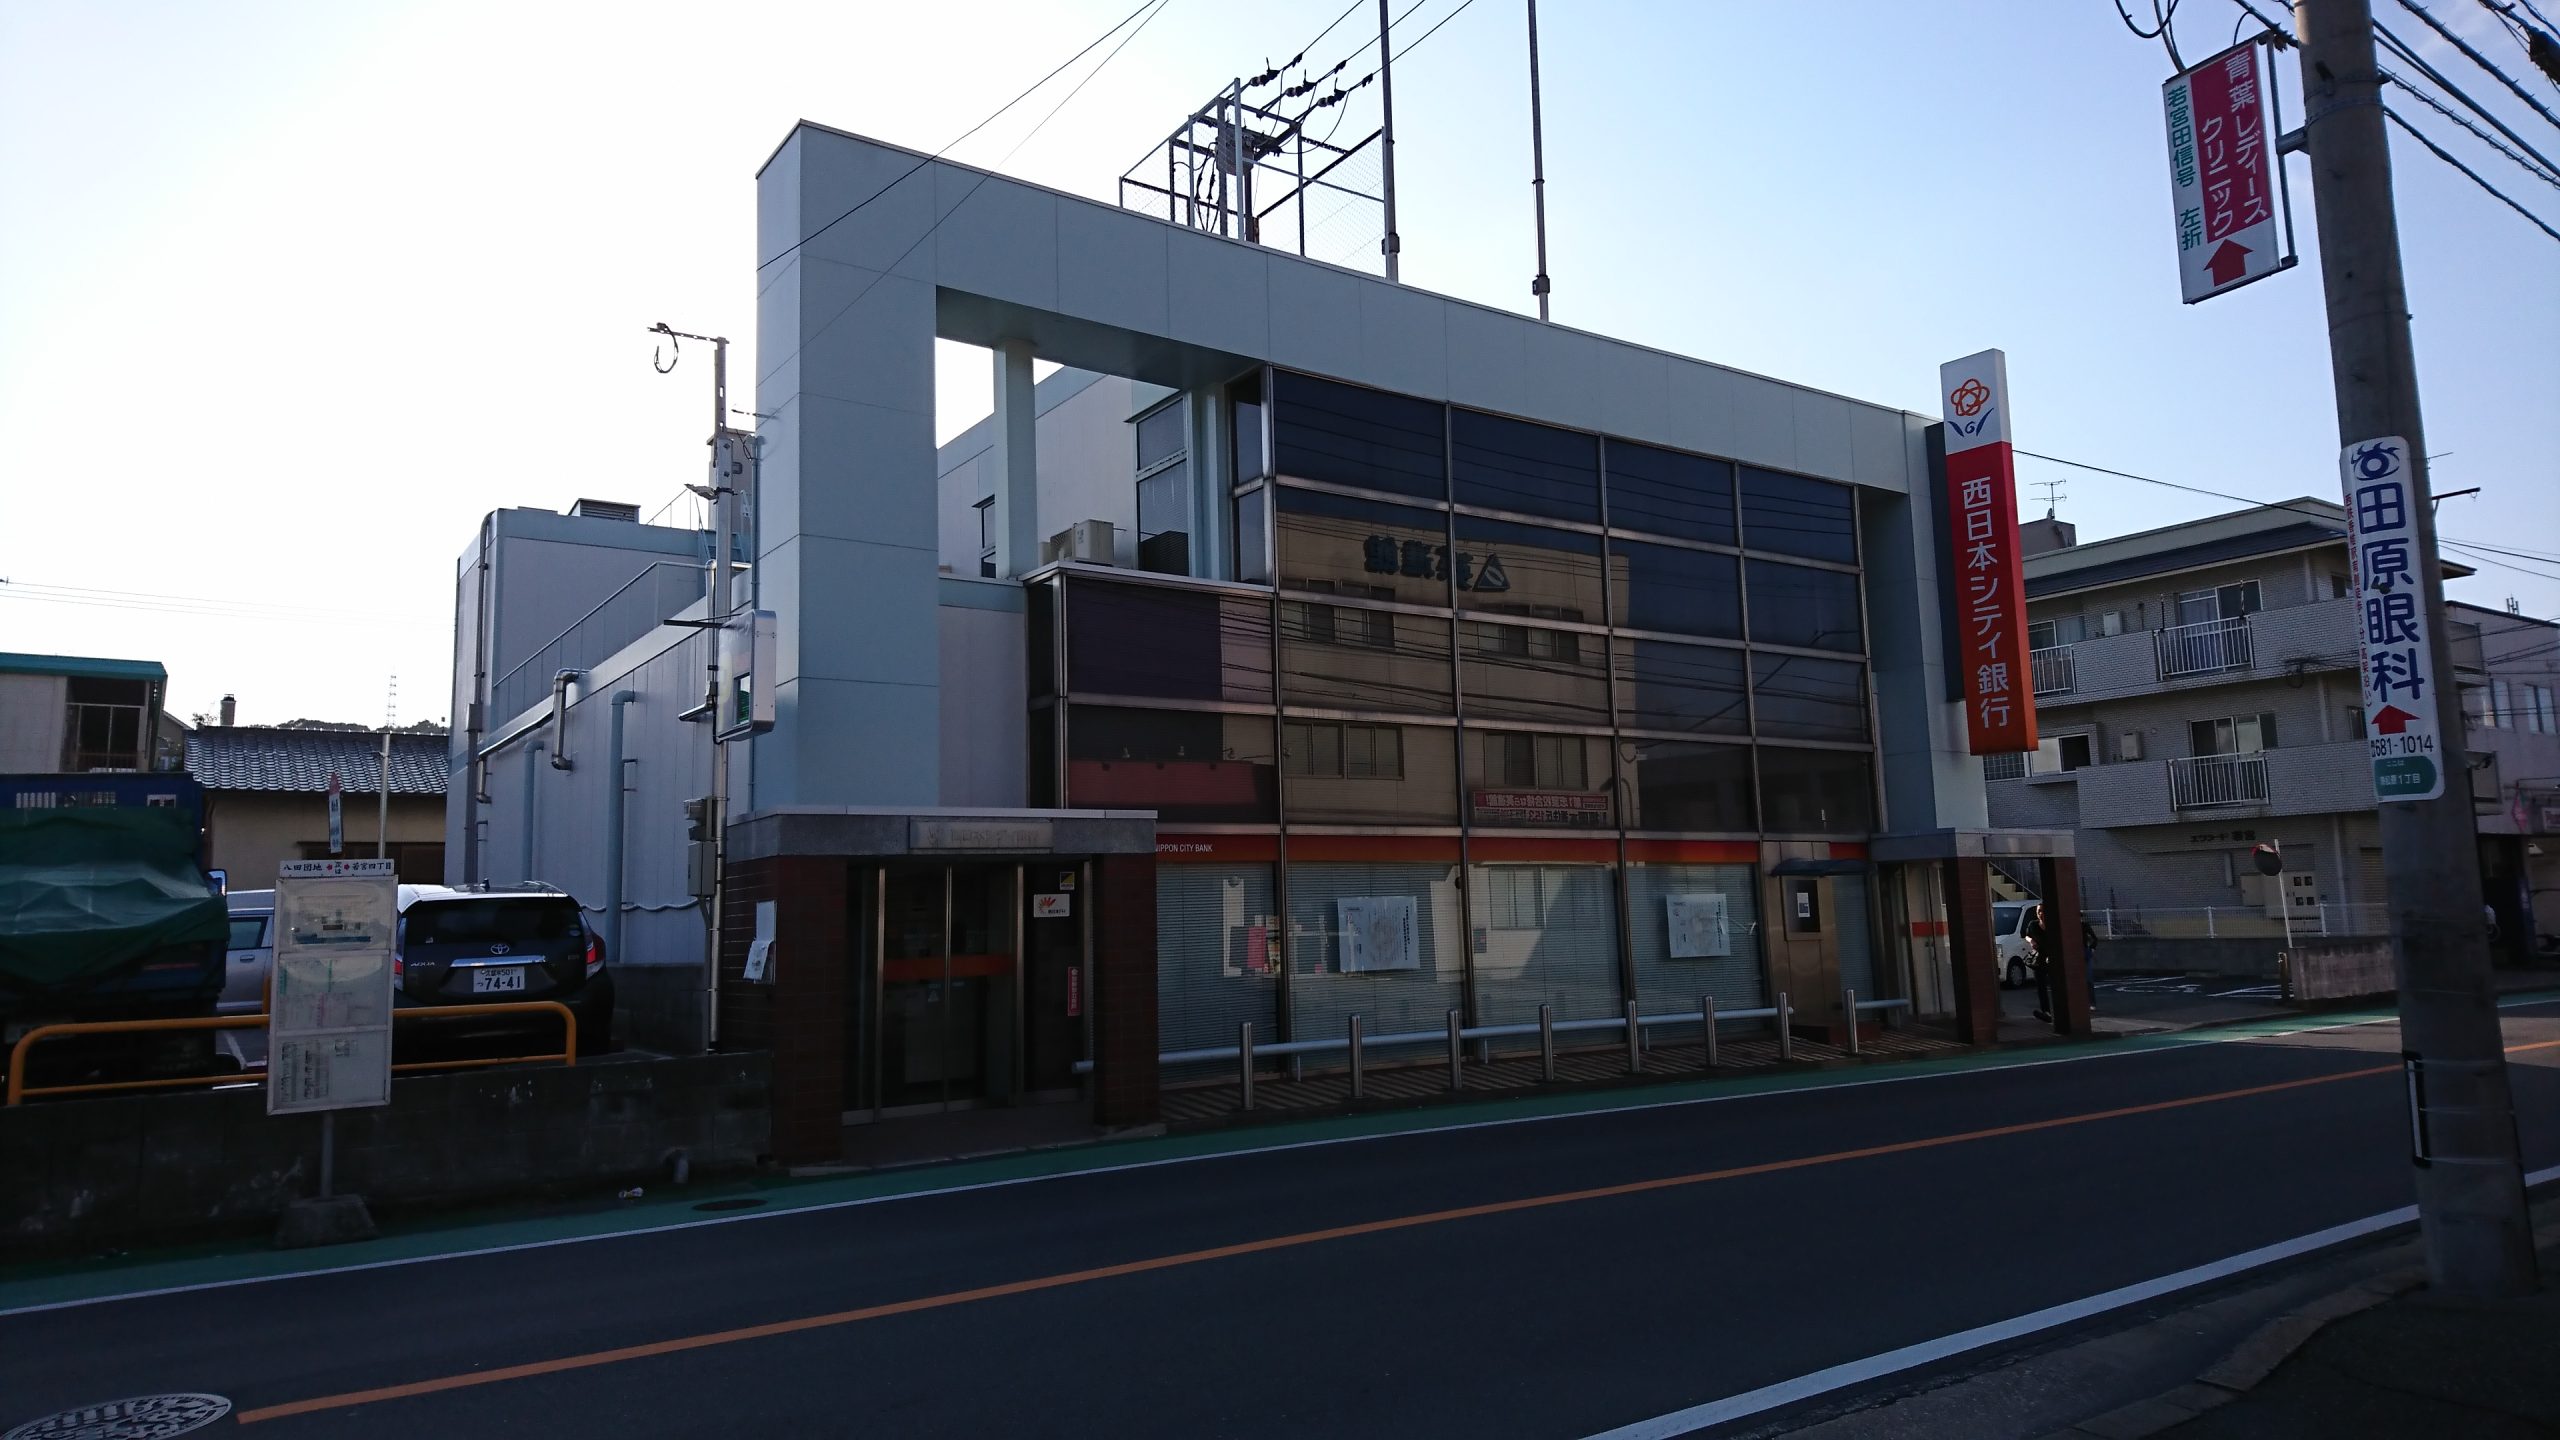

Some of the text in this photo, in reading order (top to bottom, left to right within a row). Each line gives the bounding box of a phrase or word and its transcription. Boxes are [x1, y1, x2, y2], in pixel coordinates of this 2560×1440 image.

[2167, 84, 2202, 252] 若宮田信号 左折
[2201, 117, 2234, 238] クリニック
[2224, 51, 2269, 225] 青葉レディース
[1961, 477, 2012, 729] 西日本シティ銀行
[2357, 481, 2425, 703] 田原眼科
[1179, 843, 1194, 853] CITY
[1195, 843, 1213, 853] BANK
[485, 976, 520, 990] 74-41
